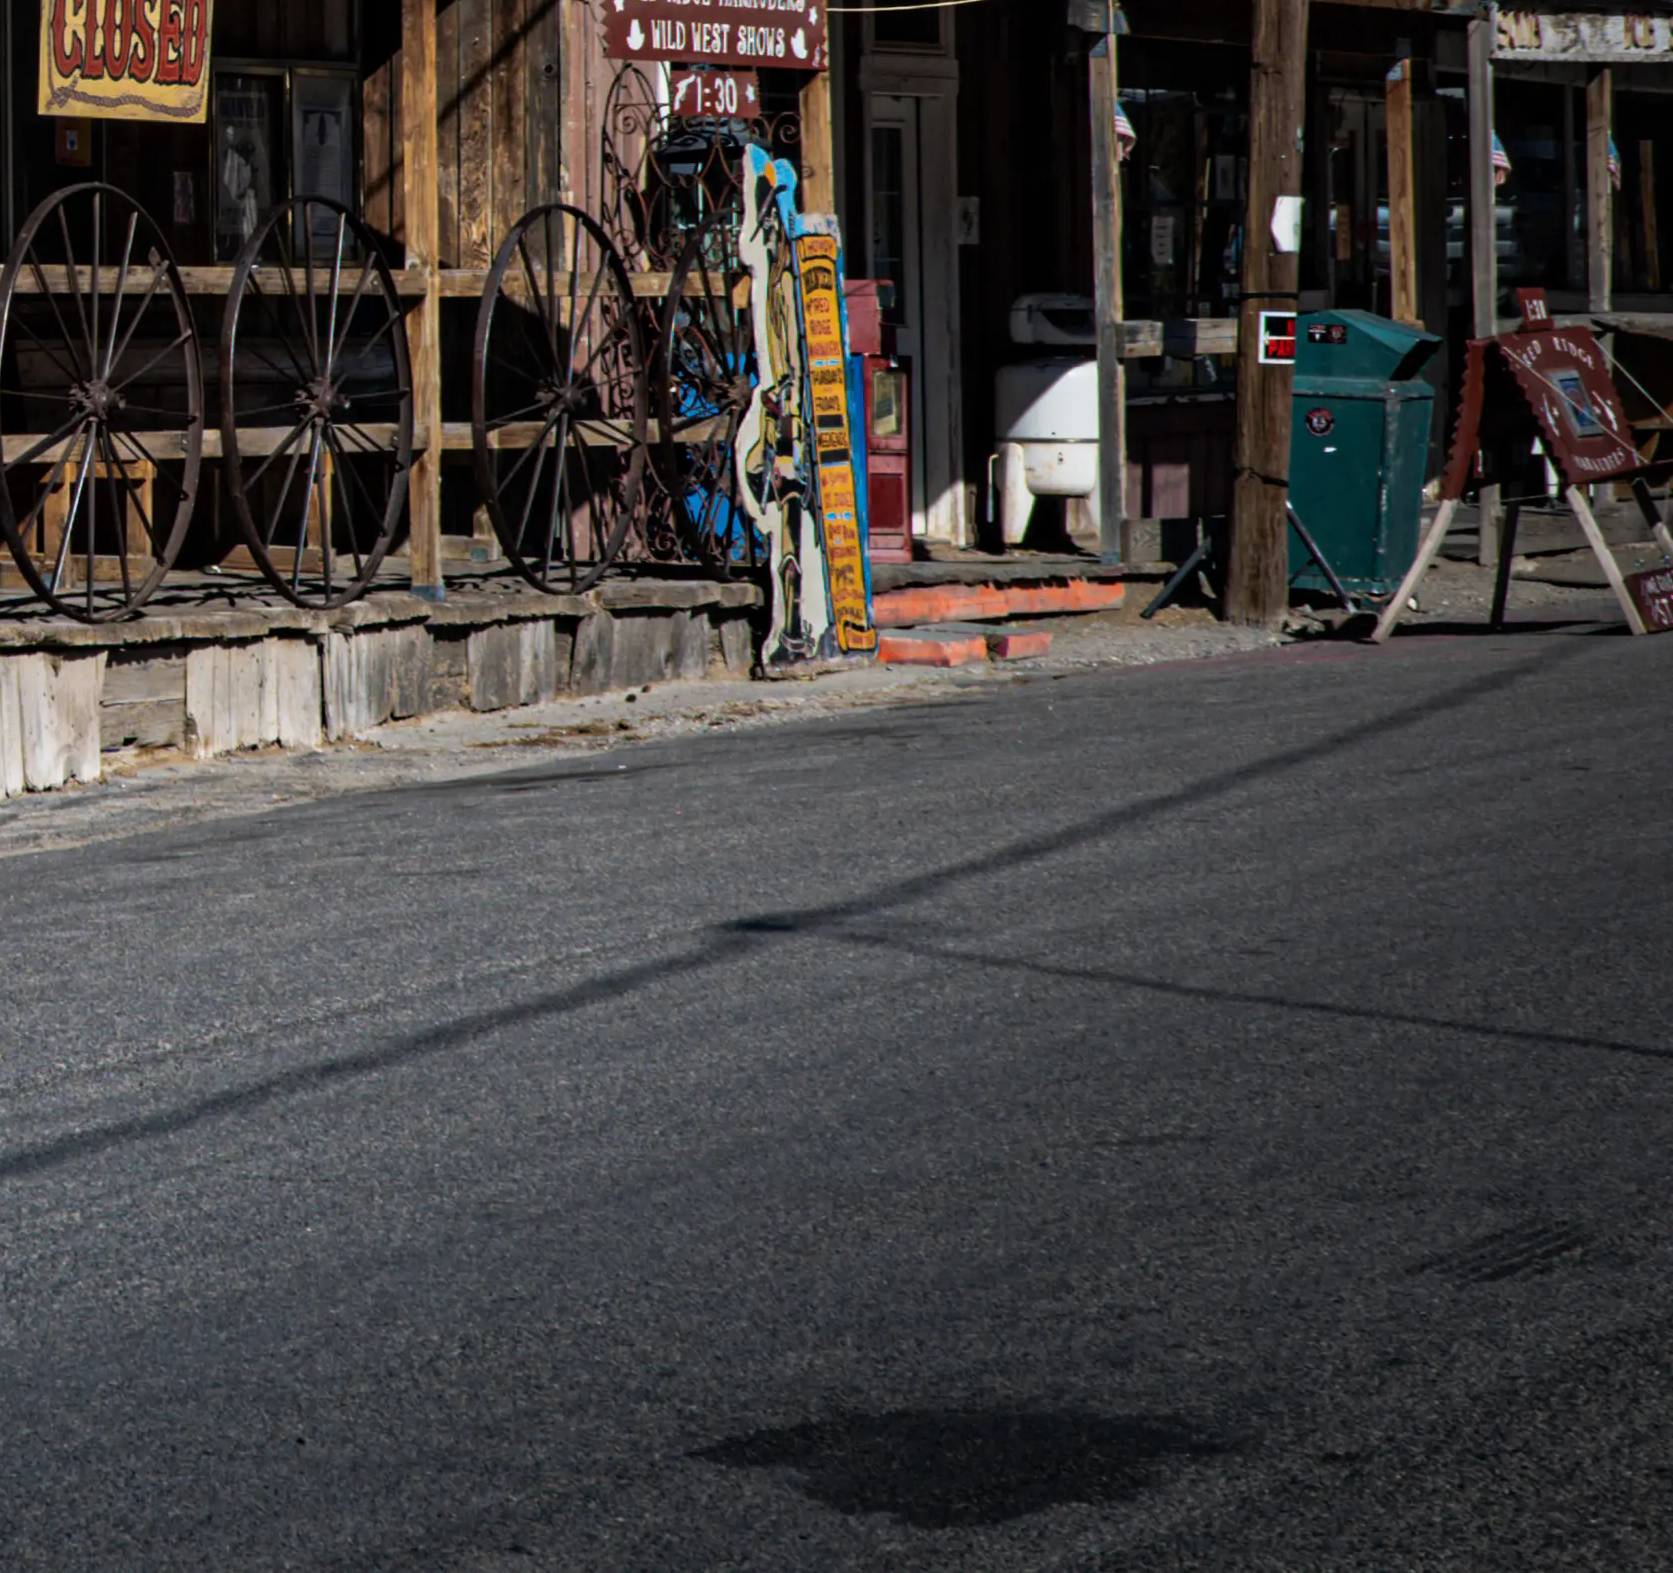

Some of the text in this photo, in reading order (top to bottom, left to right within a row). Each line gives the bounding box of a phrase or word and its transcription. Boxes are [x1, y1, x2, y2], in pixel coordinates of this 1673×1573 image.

[650, 19, 786, 58] WILD WEST SHOWS
[695, 76, 738, 115] 1:30
